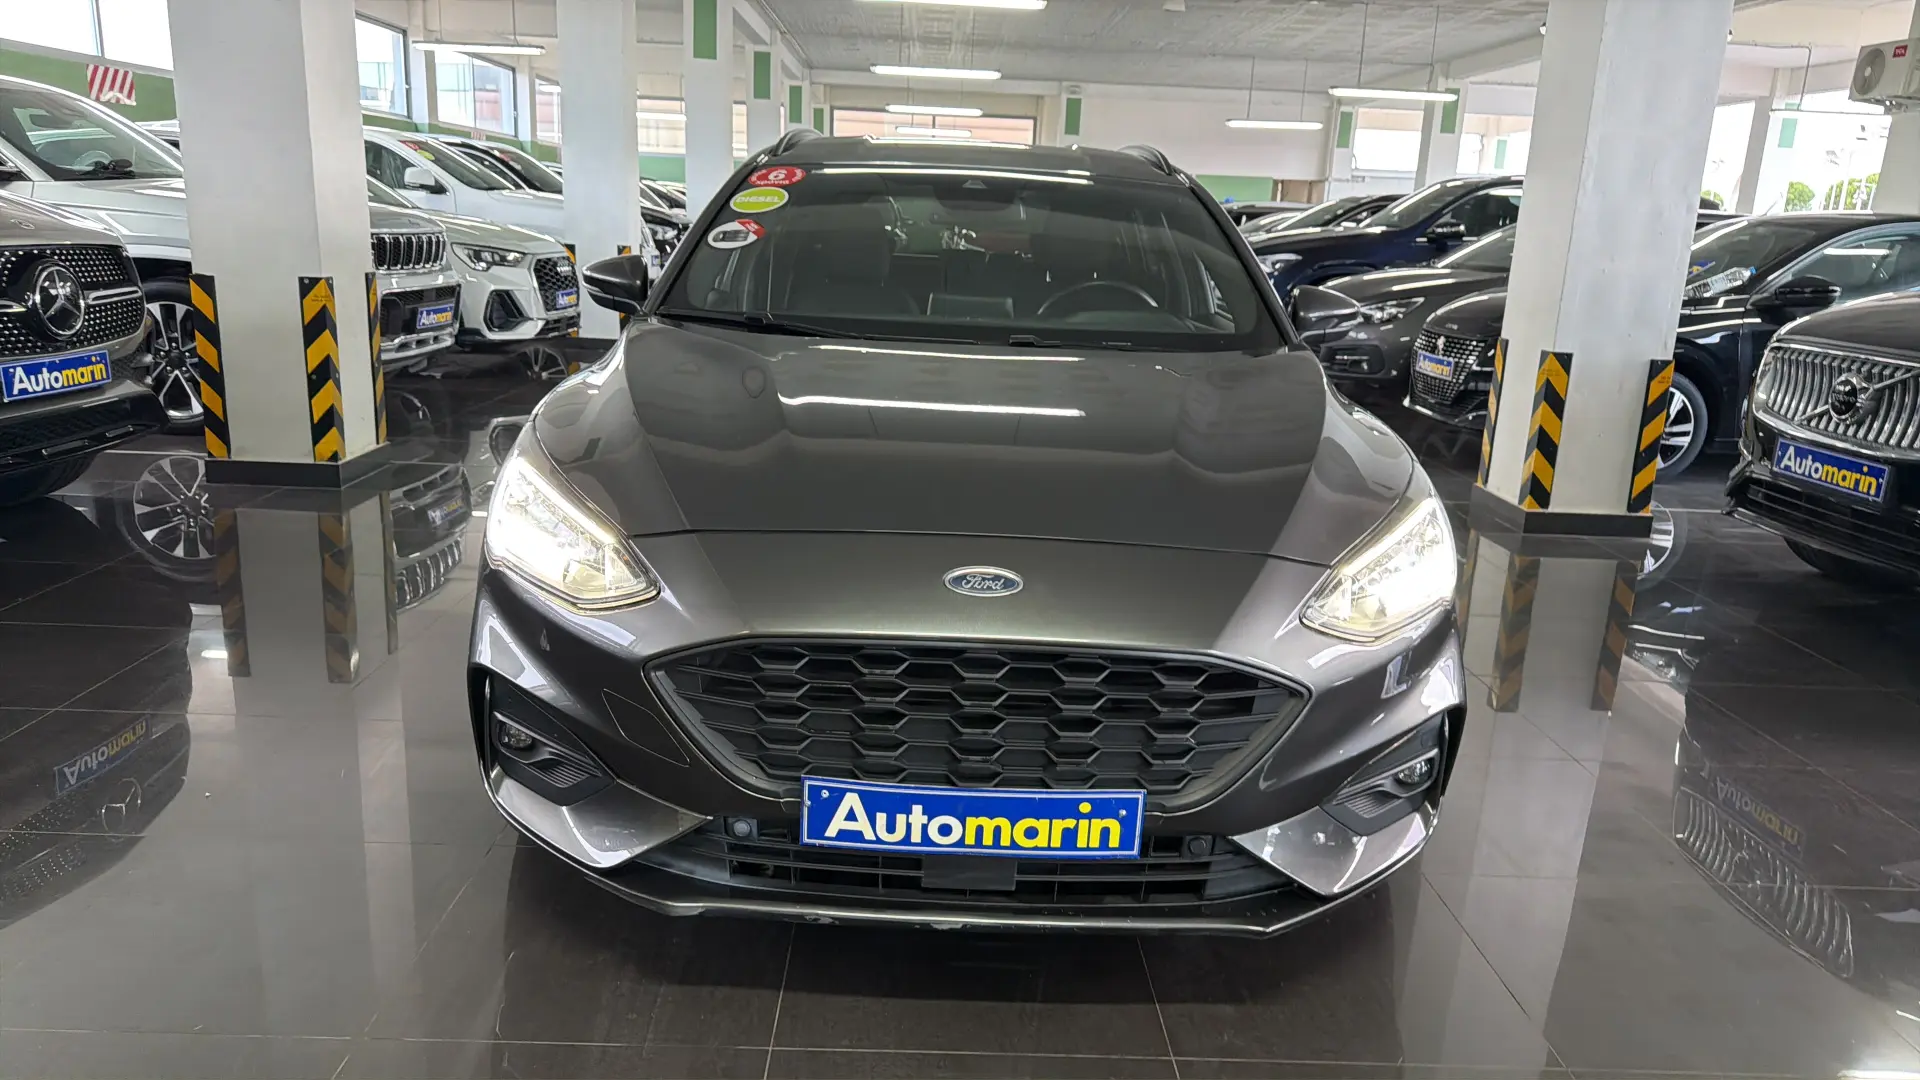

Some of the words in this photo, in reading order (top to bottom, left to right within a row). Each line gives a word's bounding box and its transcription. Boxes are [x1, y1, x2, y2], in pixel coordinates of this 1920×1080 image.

[768, 169, 787, 180] 6
[736, 195, 780, 203] DIESEL
[12, 356, 107, 395] Automarin
[1780, 445, 1878, 496] Automarin
[960, 571, 1005, 594] Ford
[824, 791, 1122, 849] Automarin
